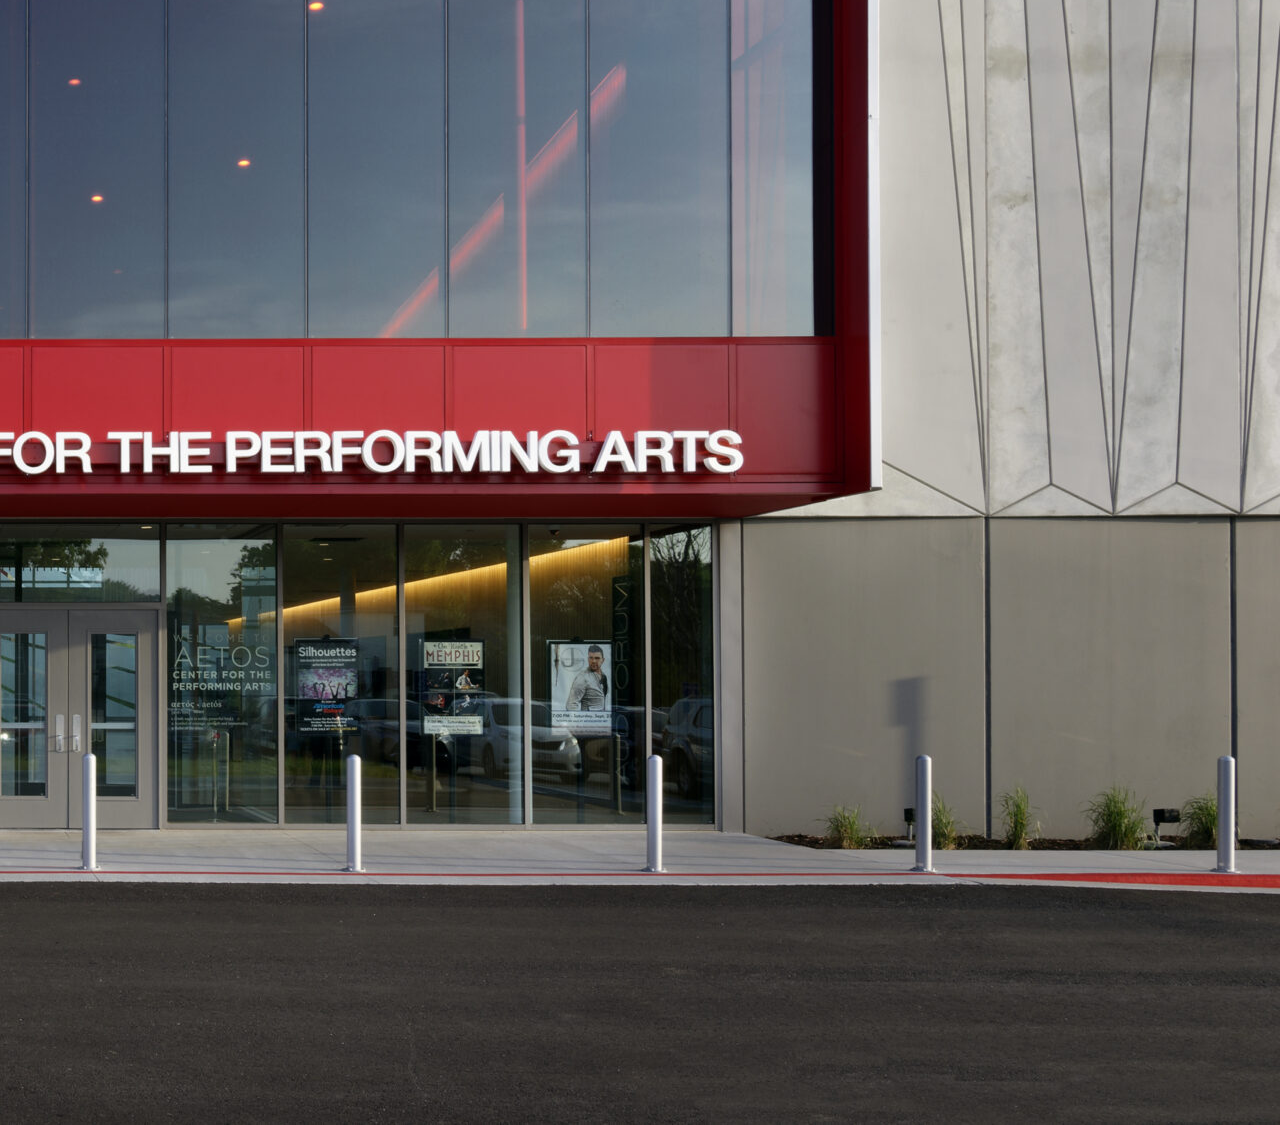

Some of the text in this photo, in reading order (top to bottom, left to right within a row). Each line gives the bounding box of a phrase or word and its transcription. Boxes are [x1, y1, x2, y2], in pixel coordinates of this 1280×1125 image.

[106, 430, 212, 474] THE
[225, 428, 583, 474] PERFORMING
[593, 429, 745, 474] ARTS
[173, 634, 245, 643] WELCOME
[174, 646, 270, 667] AETOS
[299, 646, 357, 657] Silhouettes
[426, 650, 481, 662] MEMPHIS
[172, 670, 271, 679] CENTER FOR THE
[172, 682, 271, 691] PERFORMING ARTS
